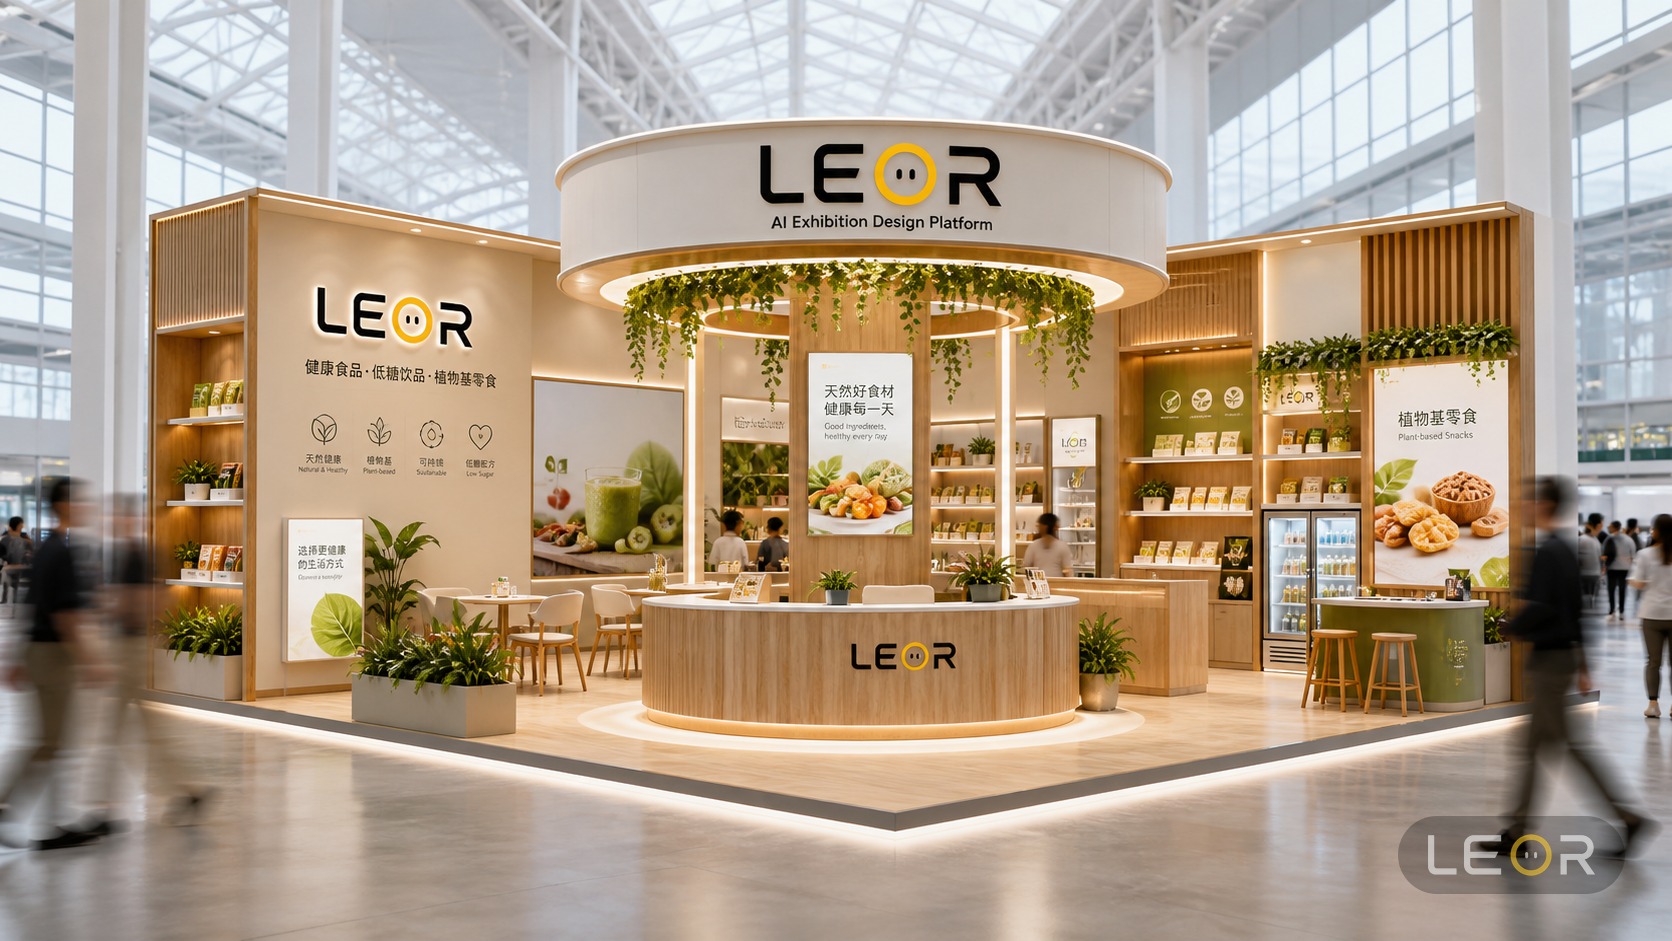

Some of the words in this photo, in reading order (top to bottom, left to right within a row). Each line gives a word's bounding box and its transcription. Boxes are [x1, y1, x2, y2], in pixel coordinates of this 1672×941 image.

[760, 142, 1002, 206] LEOR
[771, 216, 787, 229] AI
[793, 215, 868, 228] Exhibition
[873, 215, 925, 231] Design
[930, 216, 993, 231] Platform
[317, 287, 473, 348] LEOR
[824, 384, 894, 399] 天然好食材
[824, 401, 894, 416] 健康每一天
[1398, 407, 1477, 427] 植物基零食
[824, 422, 844, 430] Good
[853, 433, 873, 441] every
[1445, 430, 1474, 439] Snacks
[851, 642, 956, 671] LEOR
